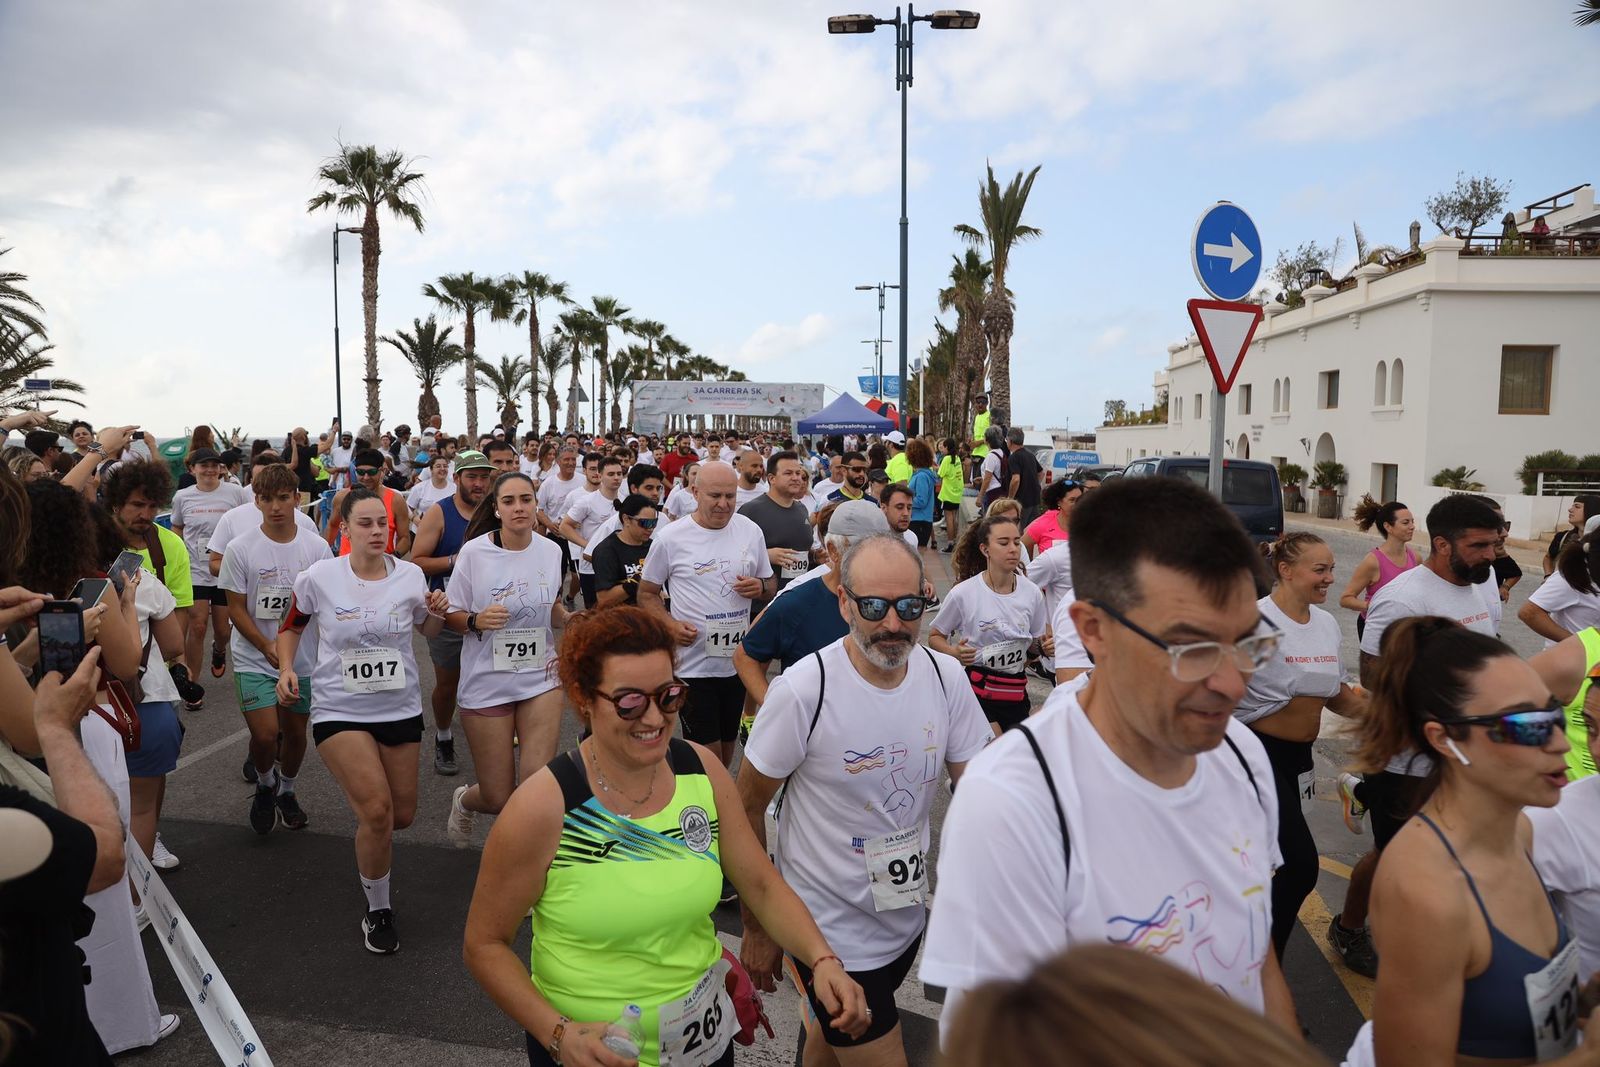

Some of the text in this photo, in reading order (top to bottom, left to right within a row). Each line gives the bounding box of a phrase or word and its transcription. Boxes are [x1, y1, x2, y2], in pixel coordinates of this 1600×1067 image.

[707, 387, 748, 395] CARRERA
[505, 642, 536, 657] 791
[988, 650, 1022, 667] 1122
[348, 661, 398, 679] 1017
[1305, 781, 1315, 800] 1
[682, 992, 722, 1055] 265
